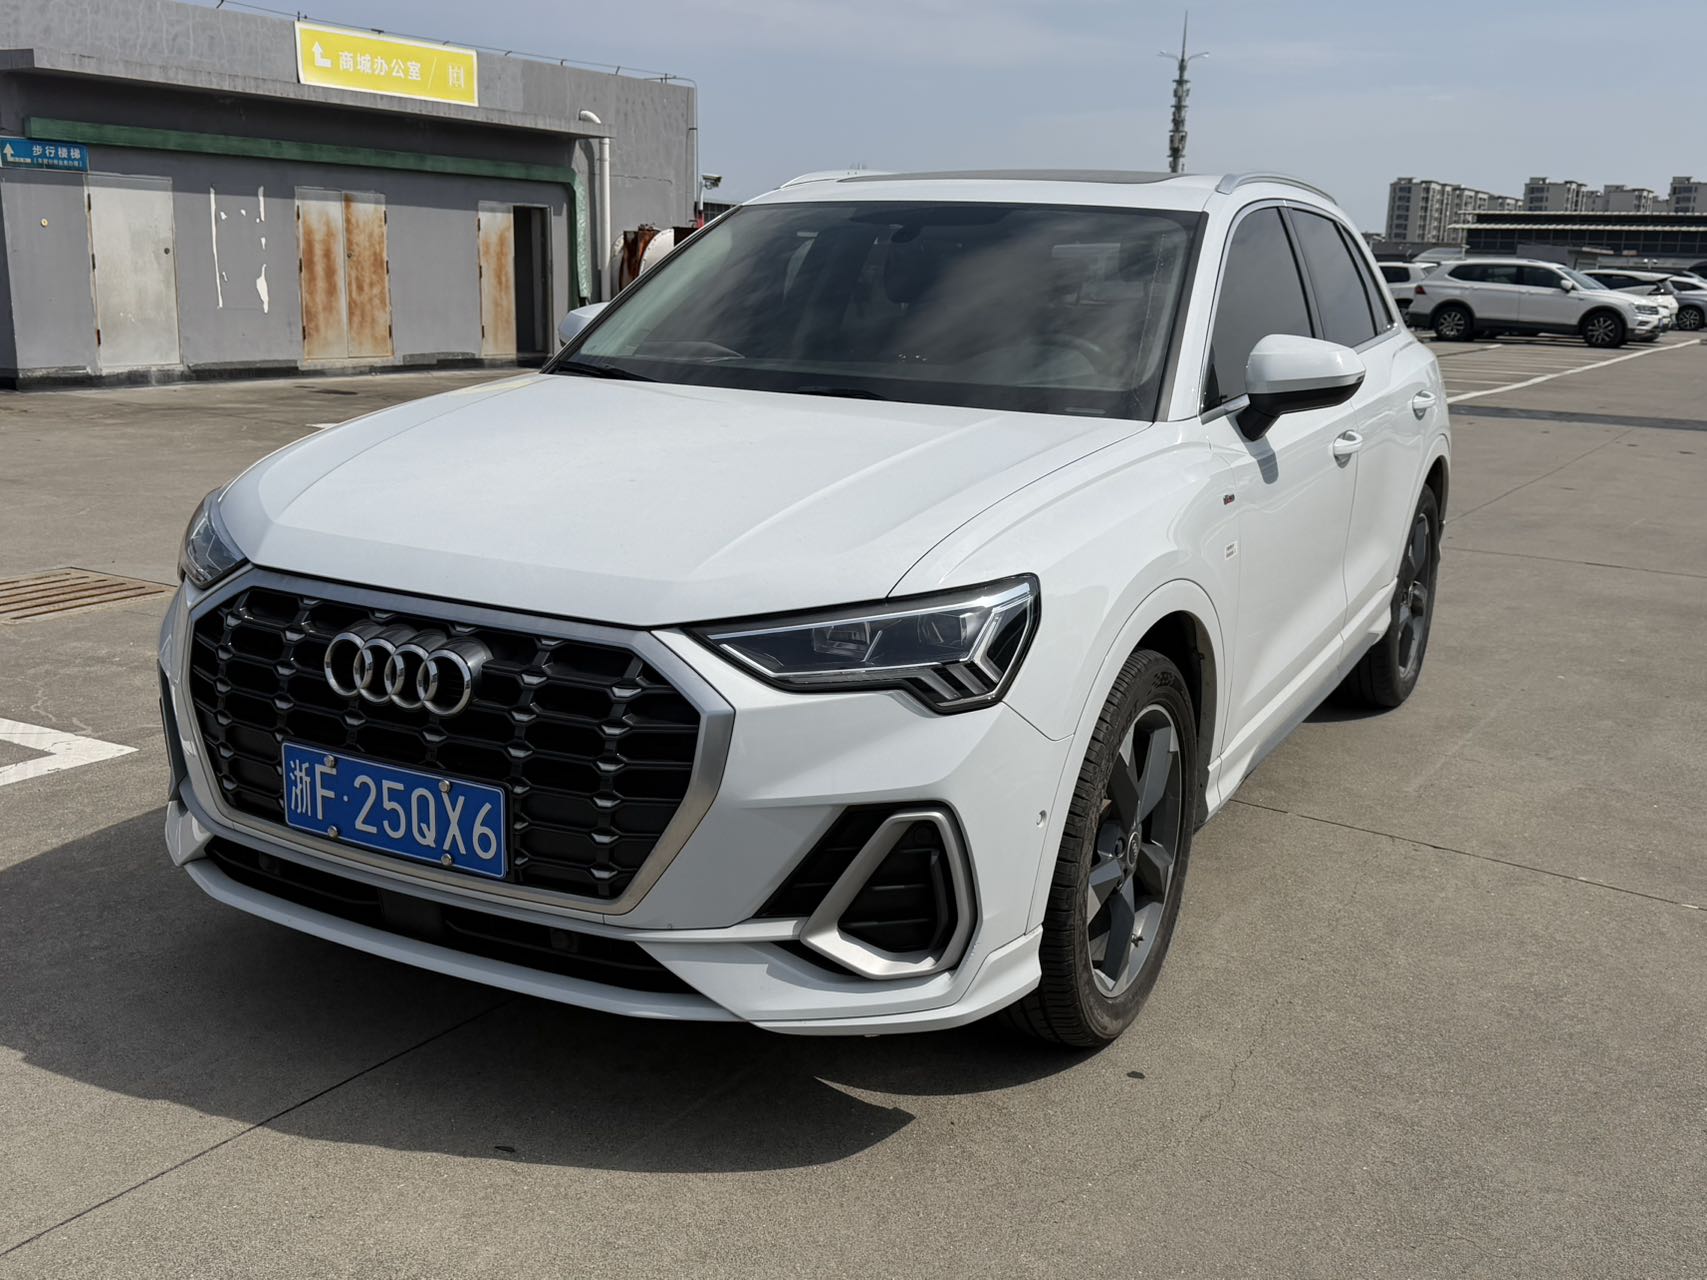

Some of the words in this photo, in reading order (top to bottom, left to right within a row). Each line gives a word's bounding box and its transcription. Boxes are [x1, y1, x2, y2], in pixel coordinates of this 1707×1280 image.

[339, 51, 422, 81] 商城办公室
[32, 144, 81, 159] 步行楼梯
